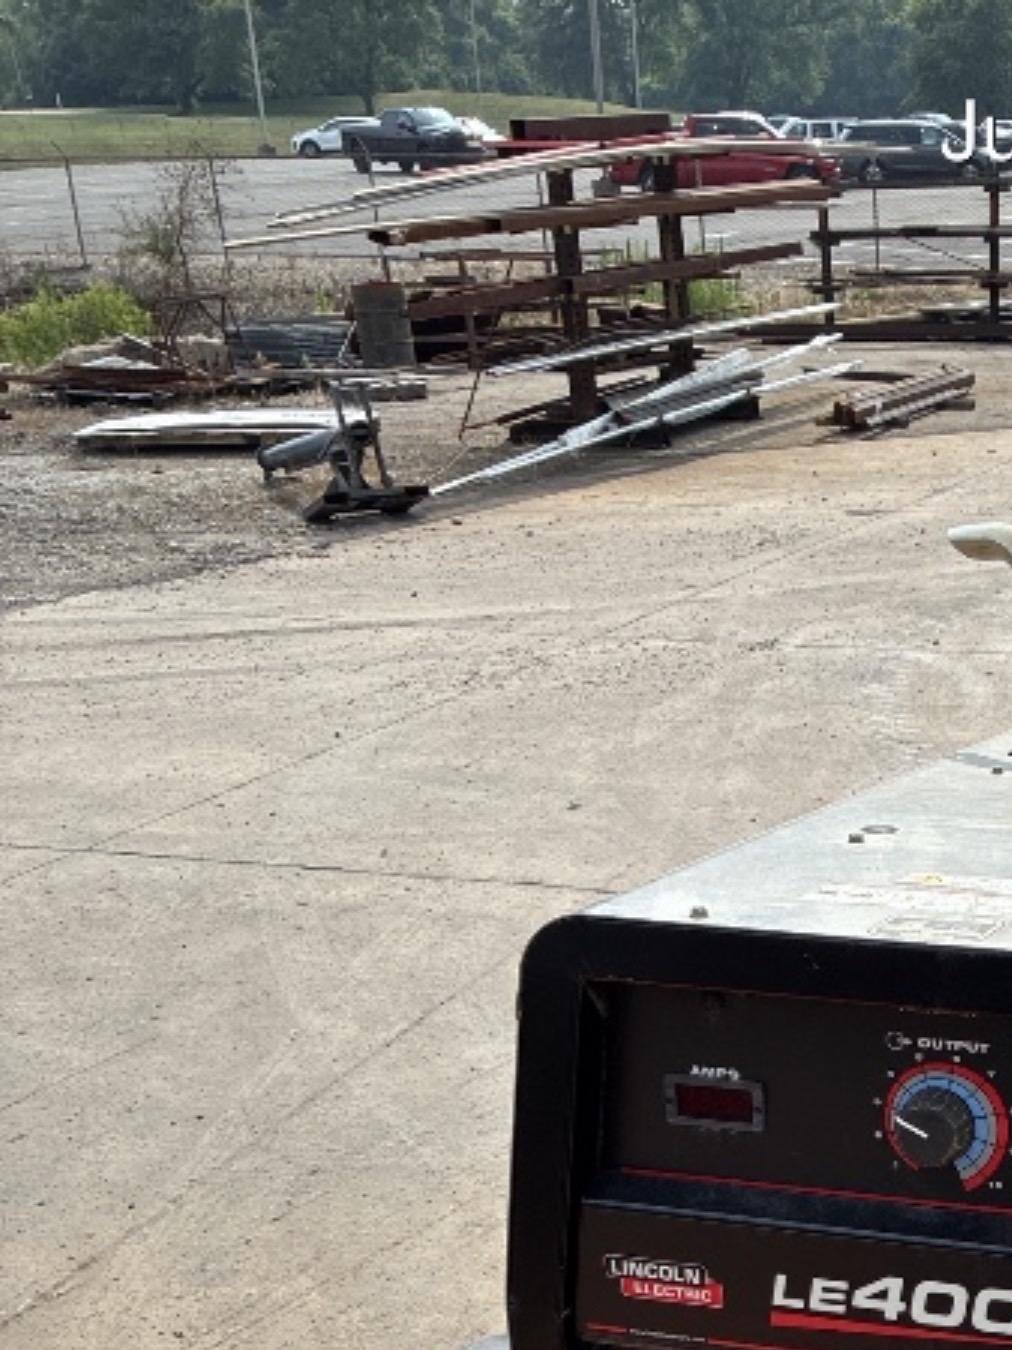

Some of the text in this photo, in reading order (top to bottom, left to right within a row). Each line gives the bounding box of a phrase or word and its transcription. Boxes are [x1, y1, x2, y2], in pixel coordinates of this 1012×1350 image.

[917, 1037, 991, 1055] OUTPUT
[690, 1064, 742, 1081] AMPS
[609, 1257, 701, 1284] LINCOLN
[632, 1281, 713, 1304] ELECTRIC
